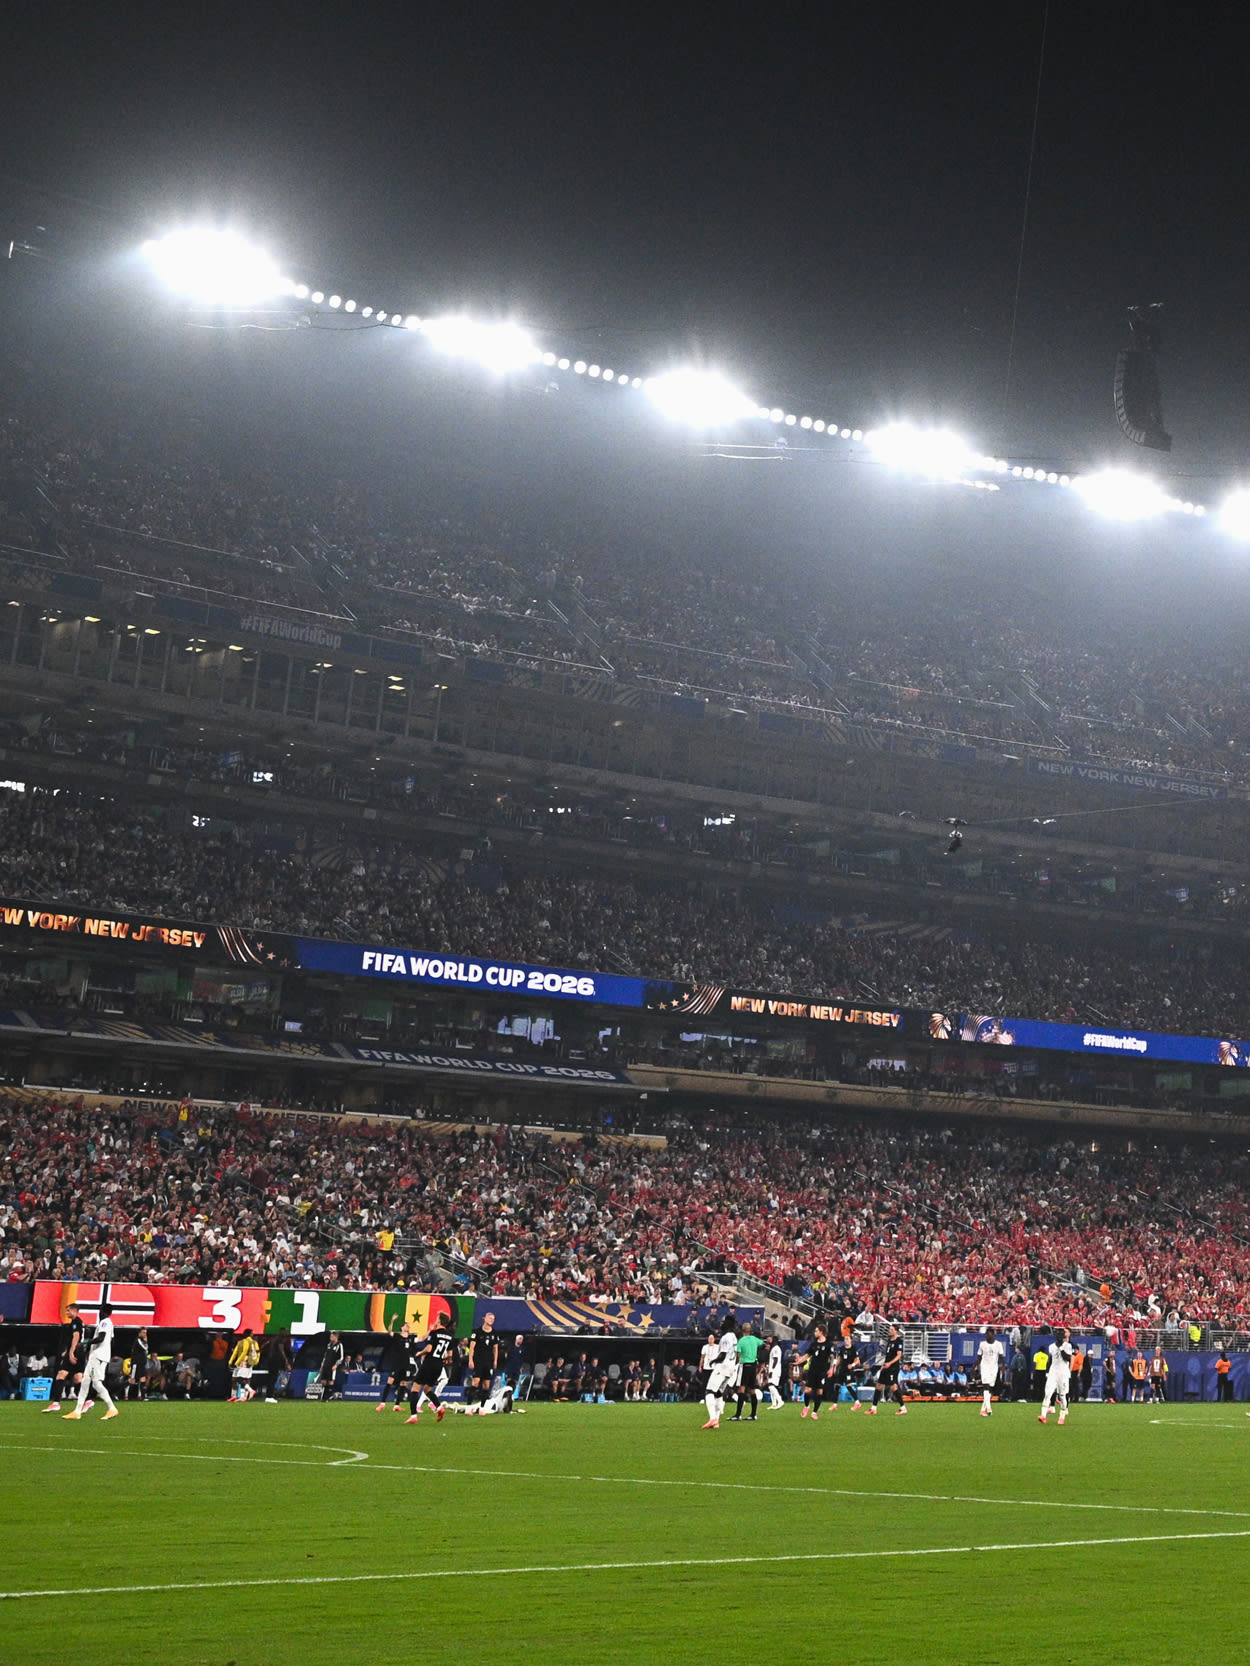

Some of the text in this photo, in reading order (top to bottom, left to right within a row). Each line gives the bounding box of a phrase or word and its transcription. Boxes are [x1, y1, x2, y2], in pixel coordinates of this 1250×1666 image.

[240, 616, 342, 649] #FIFAWorldCup
[1038, 761, 1219, 797] NEW YORK NEW JERSEY
[27, 910, 80, 932] YORK
[84, 918, 129, 939] NEW
[131, 925, 206, 948] JERSEY
[362, 951, 595, 996] FIFA WORLD CUP 2026
[730, 996, 901, 1028] NEW YORK NEW JERSEY
[1083, 1033, 1147, 1053] #FIFAWorldCup
[358, 1048, 617, 1081] FIFA WORLD CUP 2026
[198, 1288, 242, 1331] 3
[291, 1291, 326, 1335] 1
